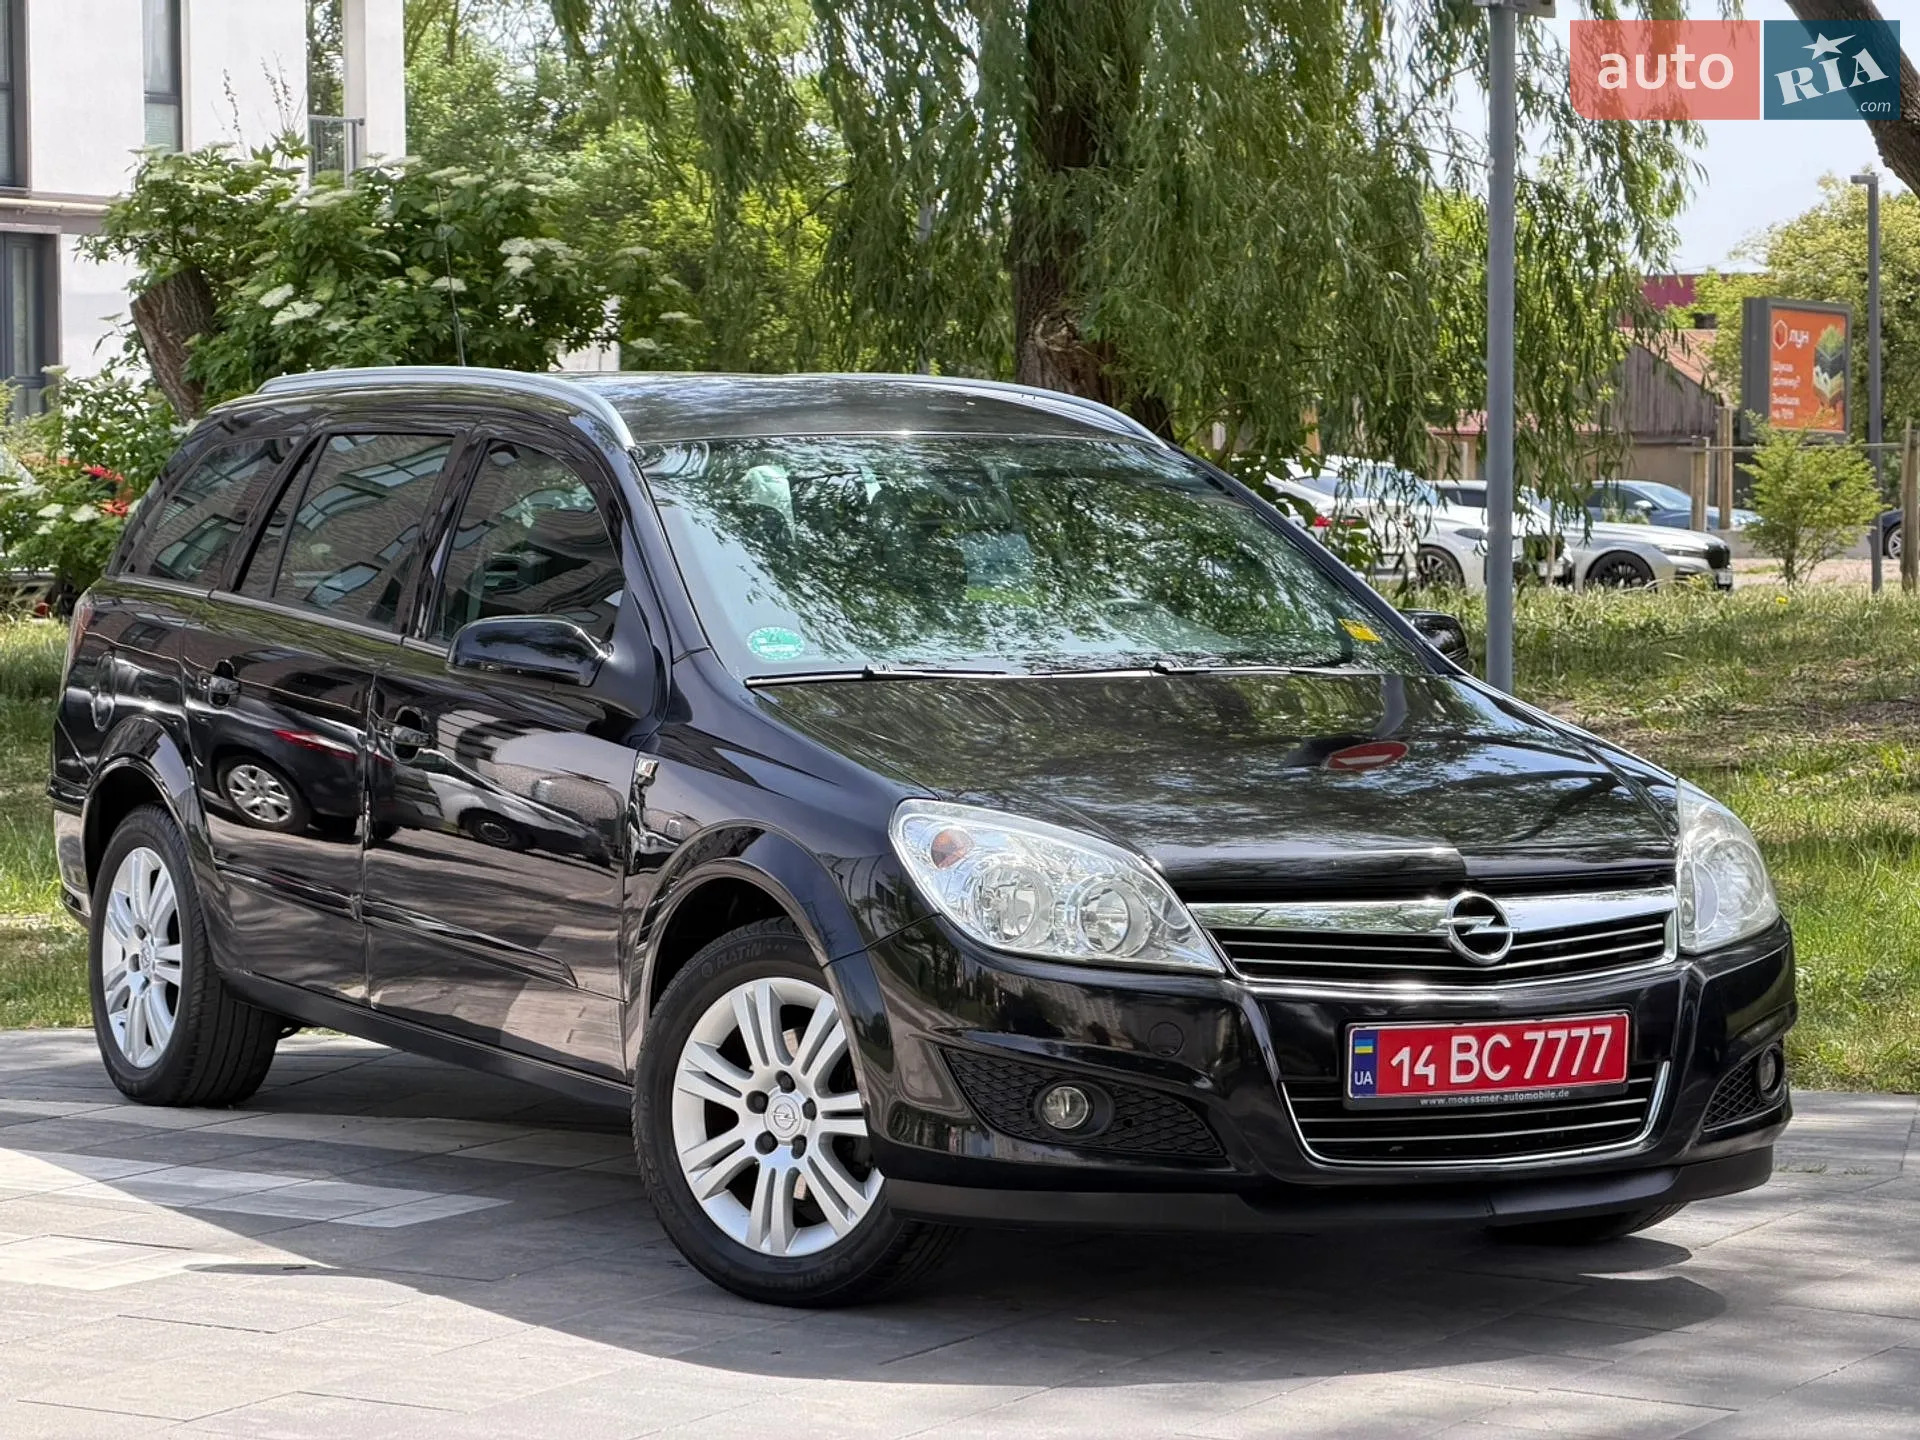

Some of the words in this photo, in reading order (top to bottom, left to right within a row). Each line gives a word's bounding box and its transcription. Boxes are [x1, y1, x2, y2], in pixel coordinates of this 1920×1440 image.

[1390, 1044, 1436, 1087] 14
[1449, 1034, 1512, 1085] BC
[1522, 1025, 1613, 1080] 7777
[1354, 1071, 1374, 1086] UA
[1419, 1089, 1570, 1106] www.moessmer-automobile.de
